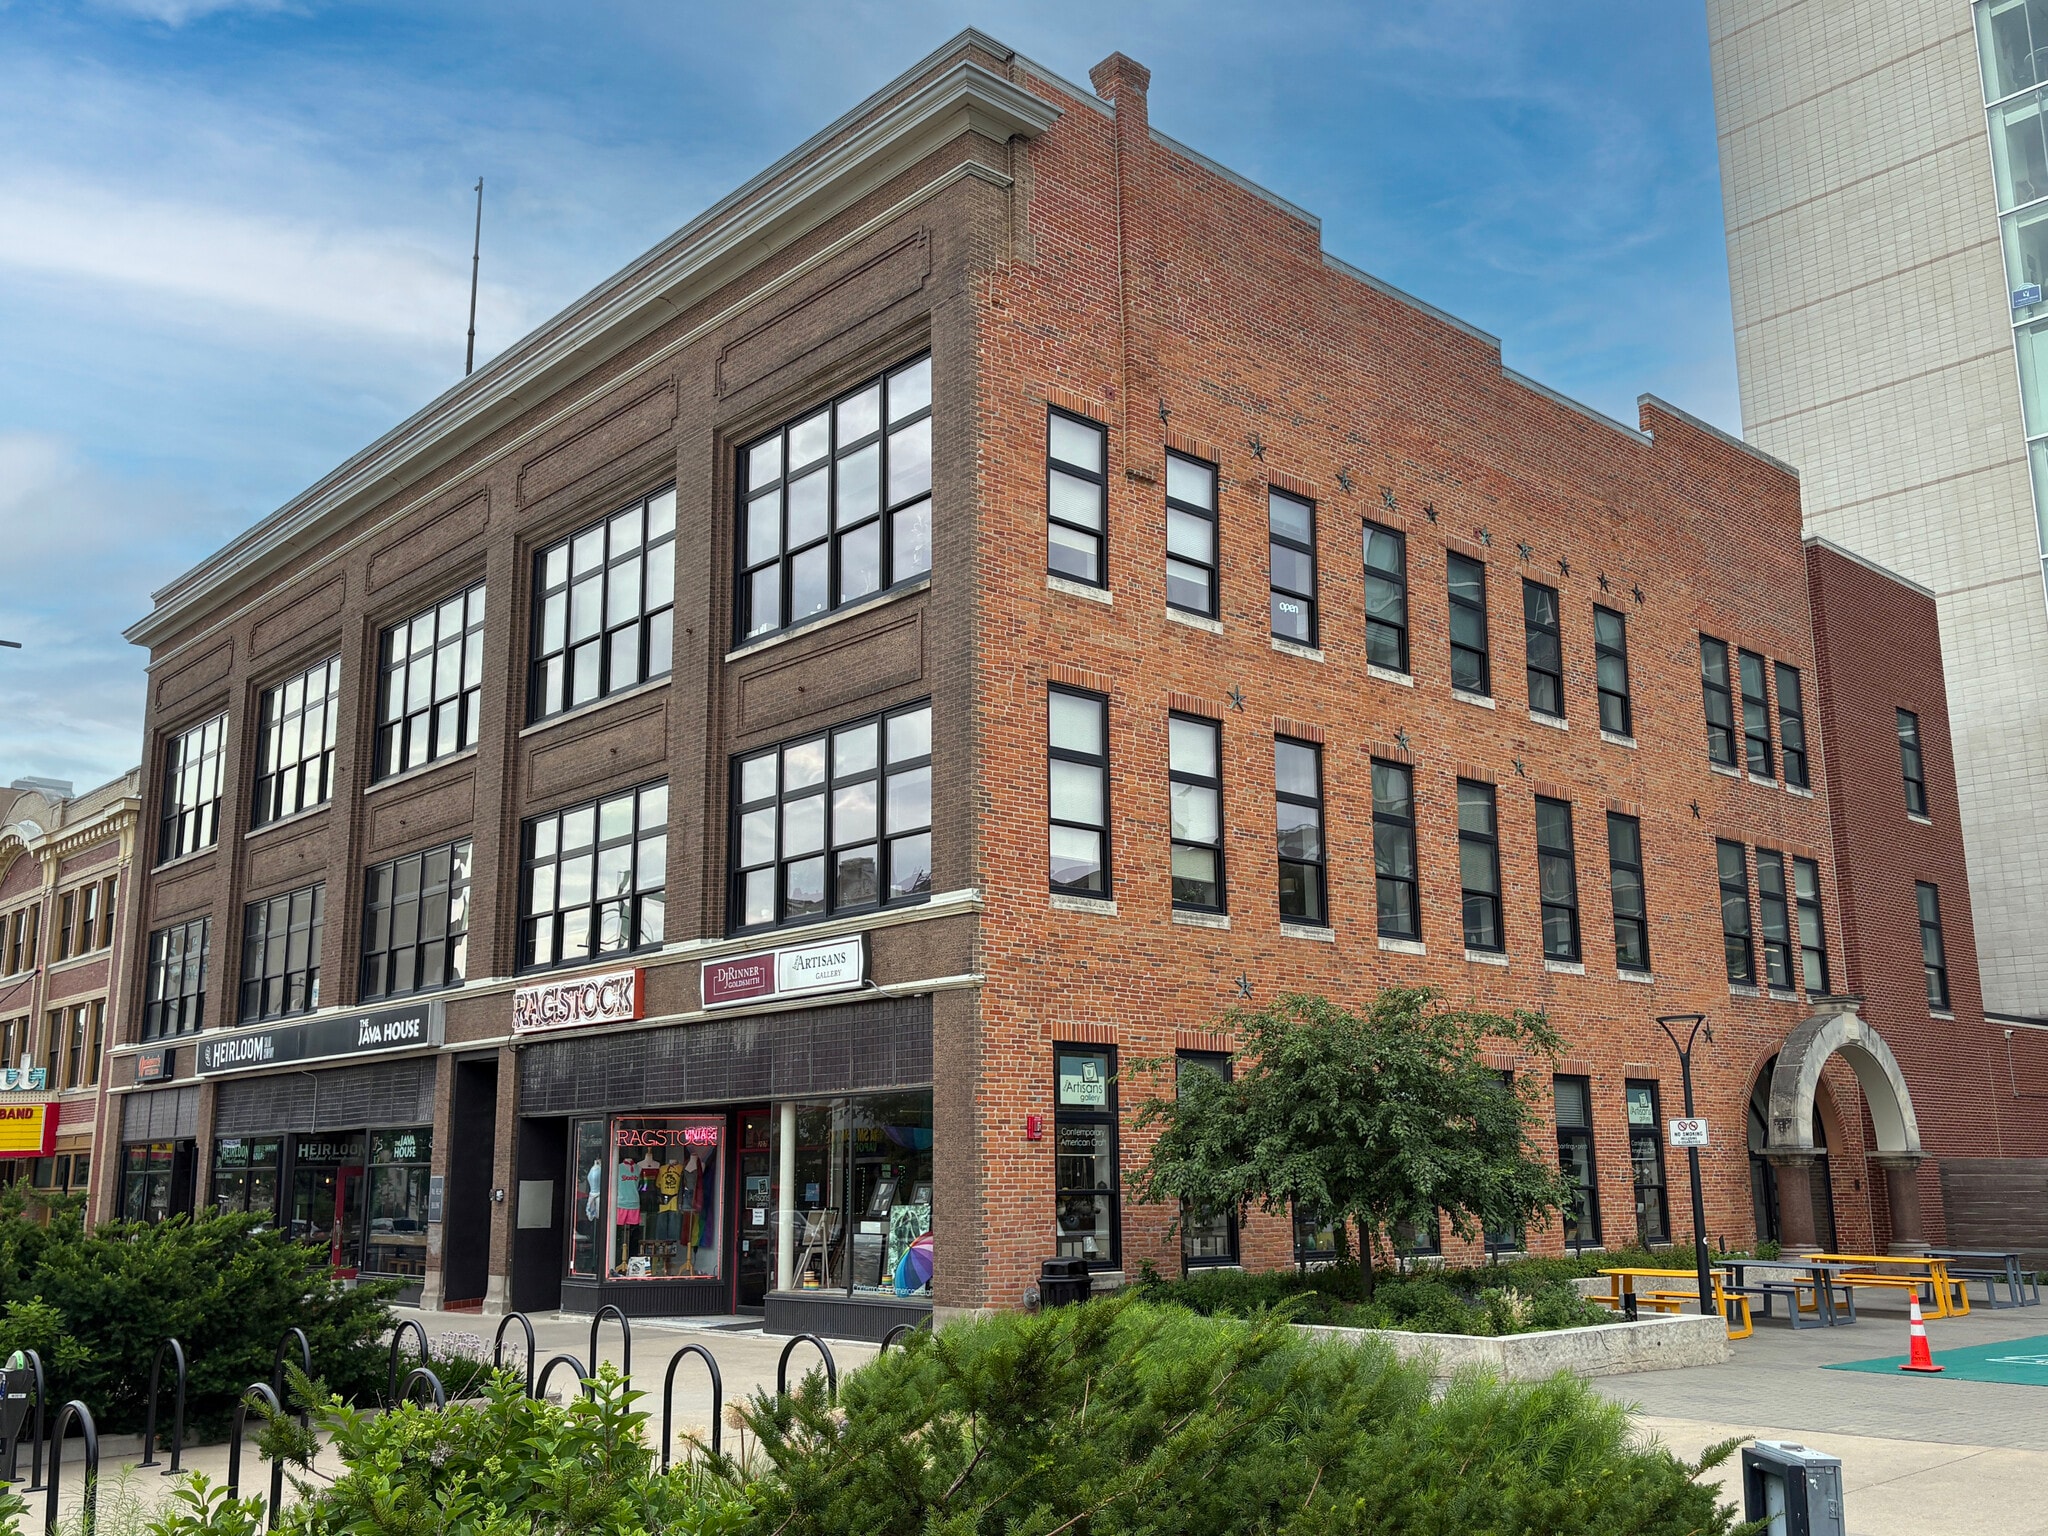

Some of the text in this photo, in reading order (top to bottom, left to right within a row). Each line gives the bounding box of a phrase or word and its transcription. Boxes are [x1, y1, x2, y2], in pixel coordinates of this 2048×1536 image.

[1279, 602, 1298, 613] open
[815, 969, 842, 979] GALLERY
[728, 977, 760, 988] GOLDSMITH
[512, 976, 634, 1028] RAGSTOCK
[359, 1018, 369, 1028] THE
[358, 1018, 420, 1046] JAVA HOUSE
[212, 1036, 264, 1068] HEIRLOOM
[1066, 1080, 1103, 1094] Artisans
[1080, 1094, 1101, 1102] gallery
[616, 1129, 717, 1146] RAGSTOCK
[1061, 1127, 1106, 1138] Contemporary
[400, 1135, 416, 1147] JAVA
[1060, 1138, 1090, 1147] American
[394, 1146, 417, 1158] HOUSE
